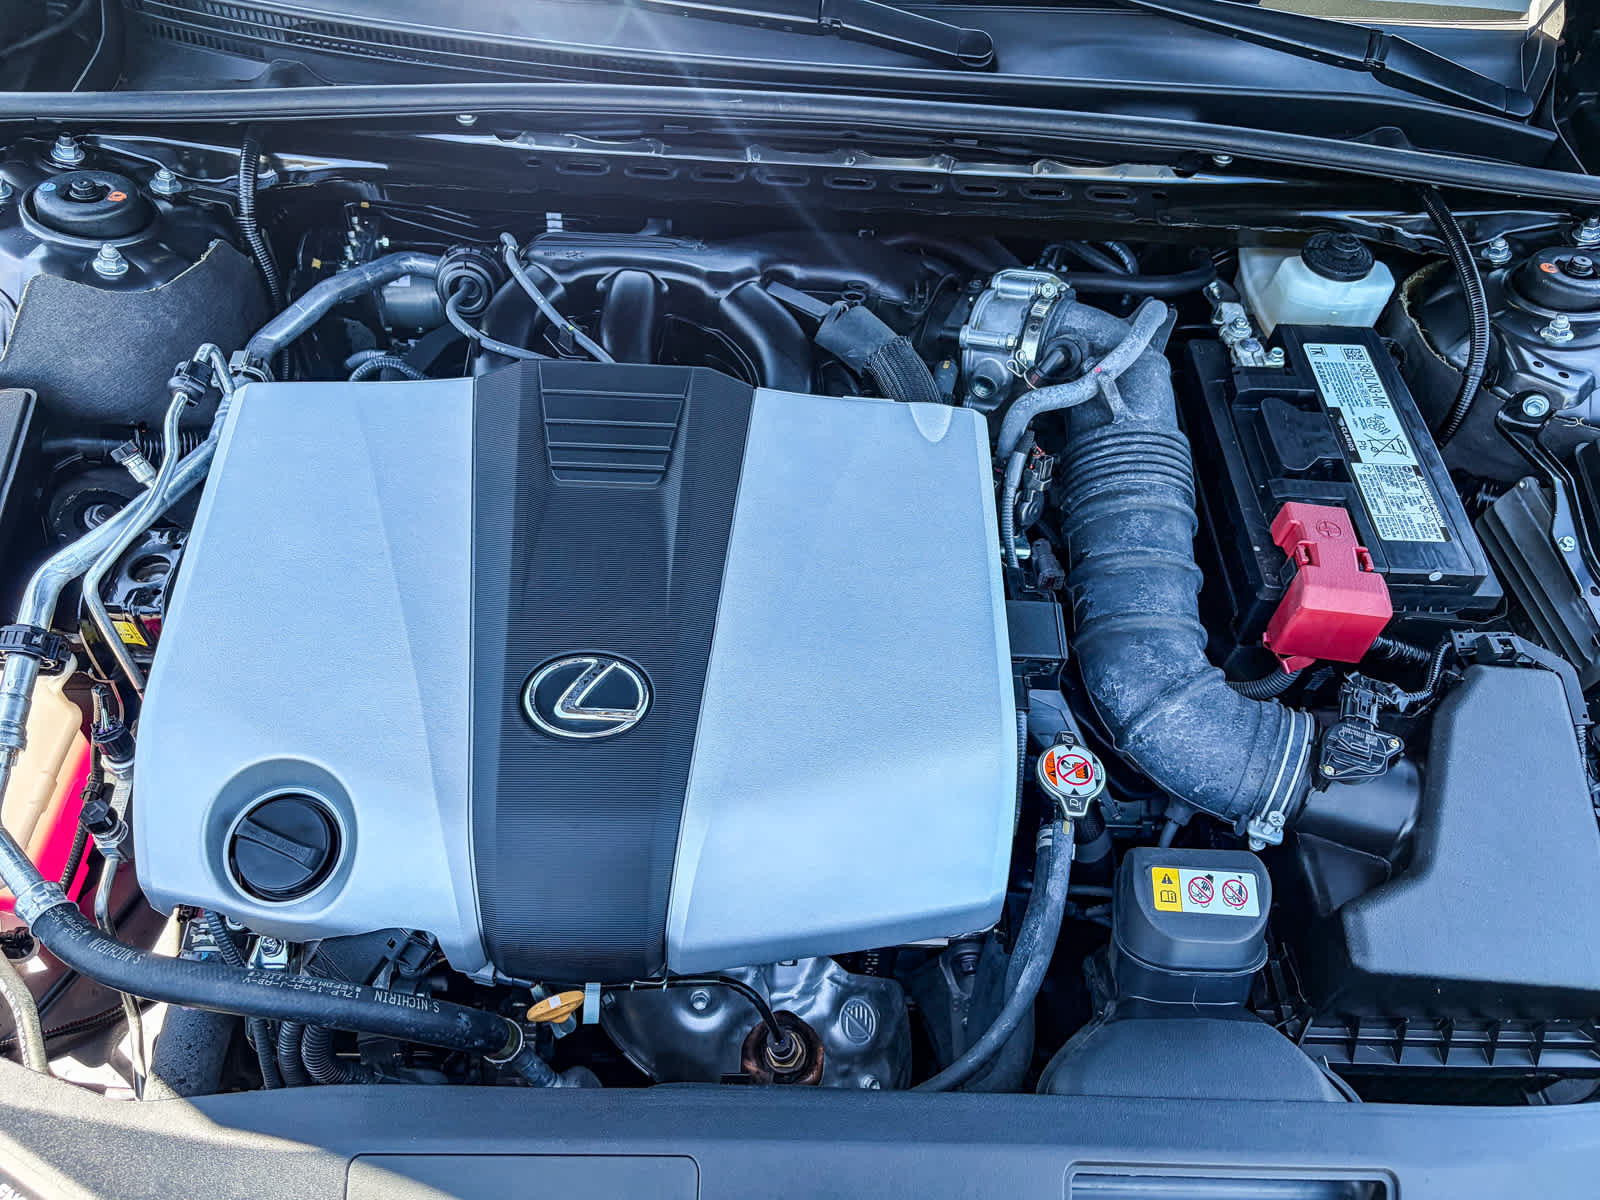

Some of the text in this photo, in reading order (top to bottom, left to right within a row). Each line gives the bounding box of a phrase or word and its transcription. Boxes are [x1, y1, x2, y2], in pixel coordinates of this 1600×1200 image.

[1358, 363, 1390, 409] 380LN3-MF
[1340, 426, 1355, 452] CLARIOS
[1358, 439, 1367, 450] Pb
